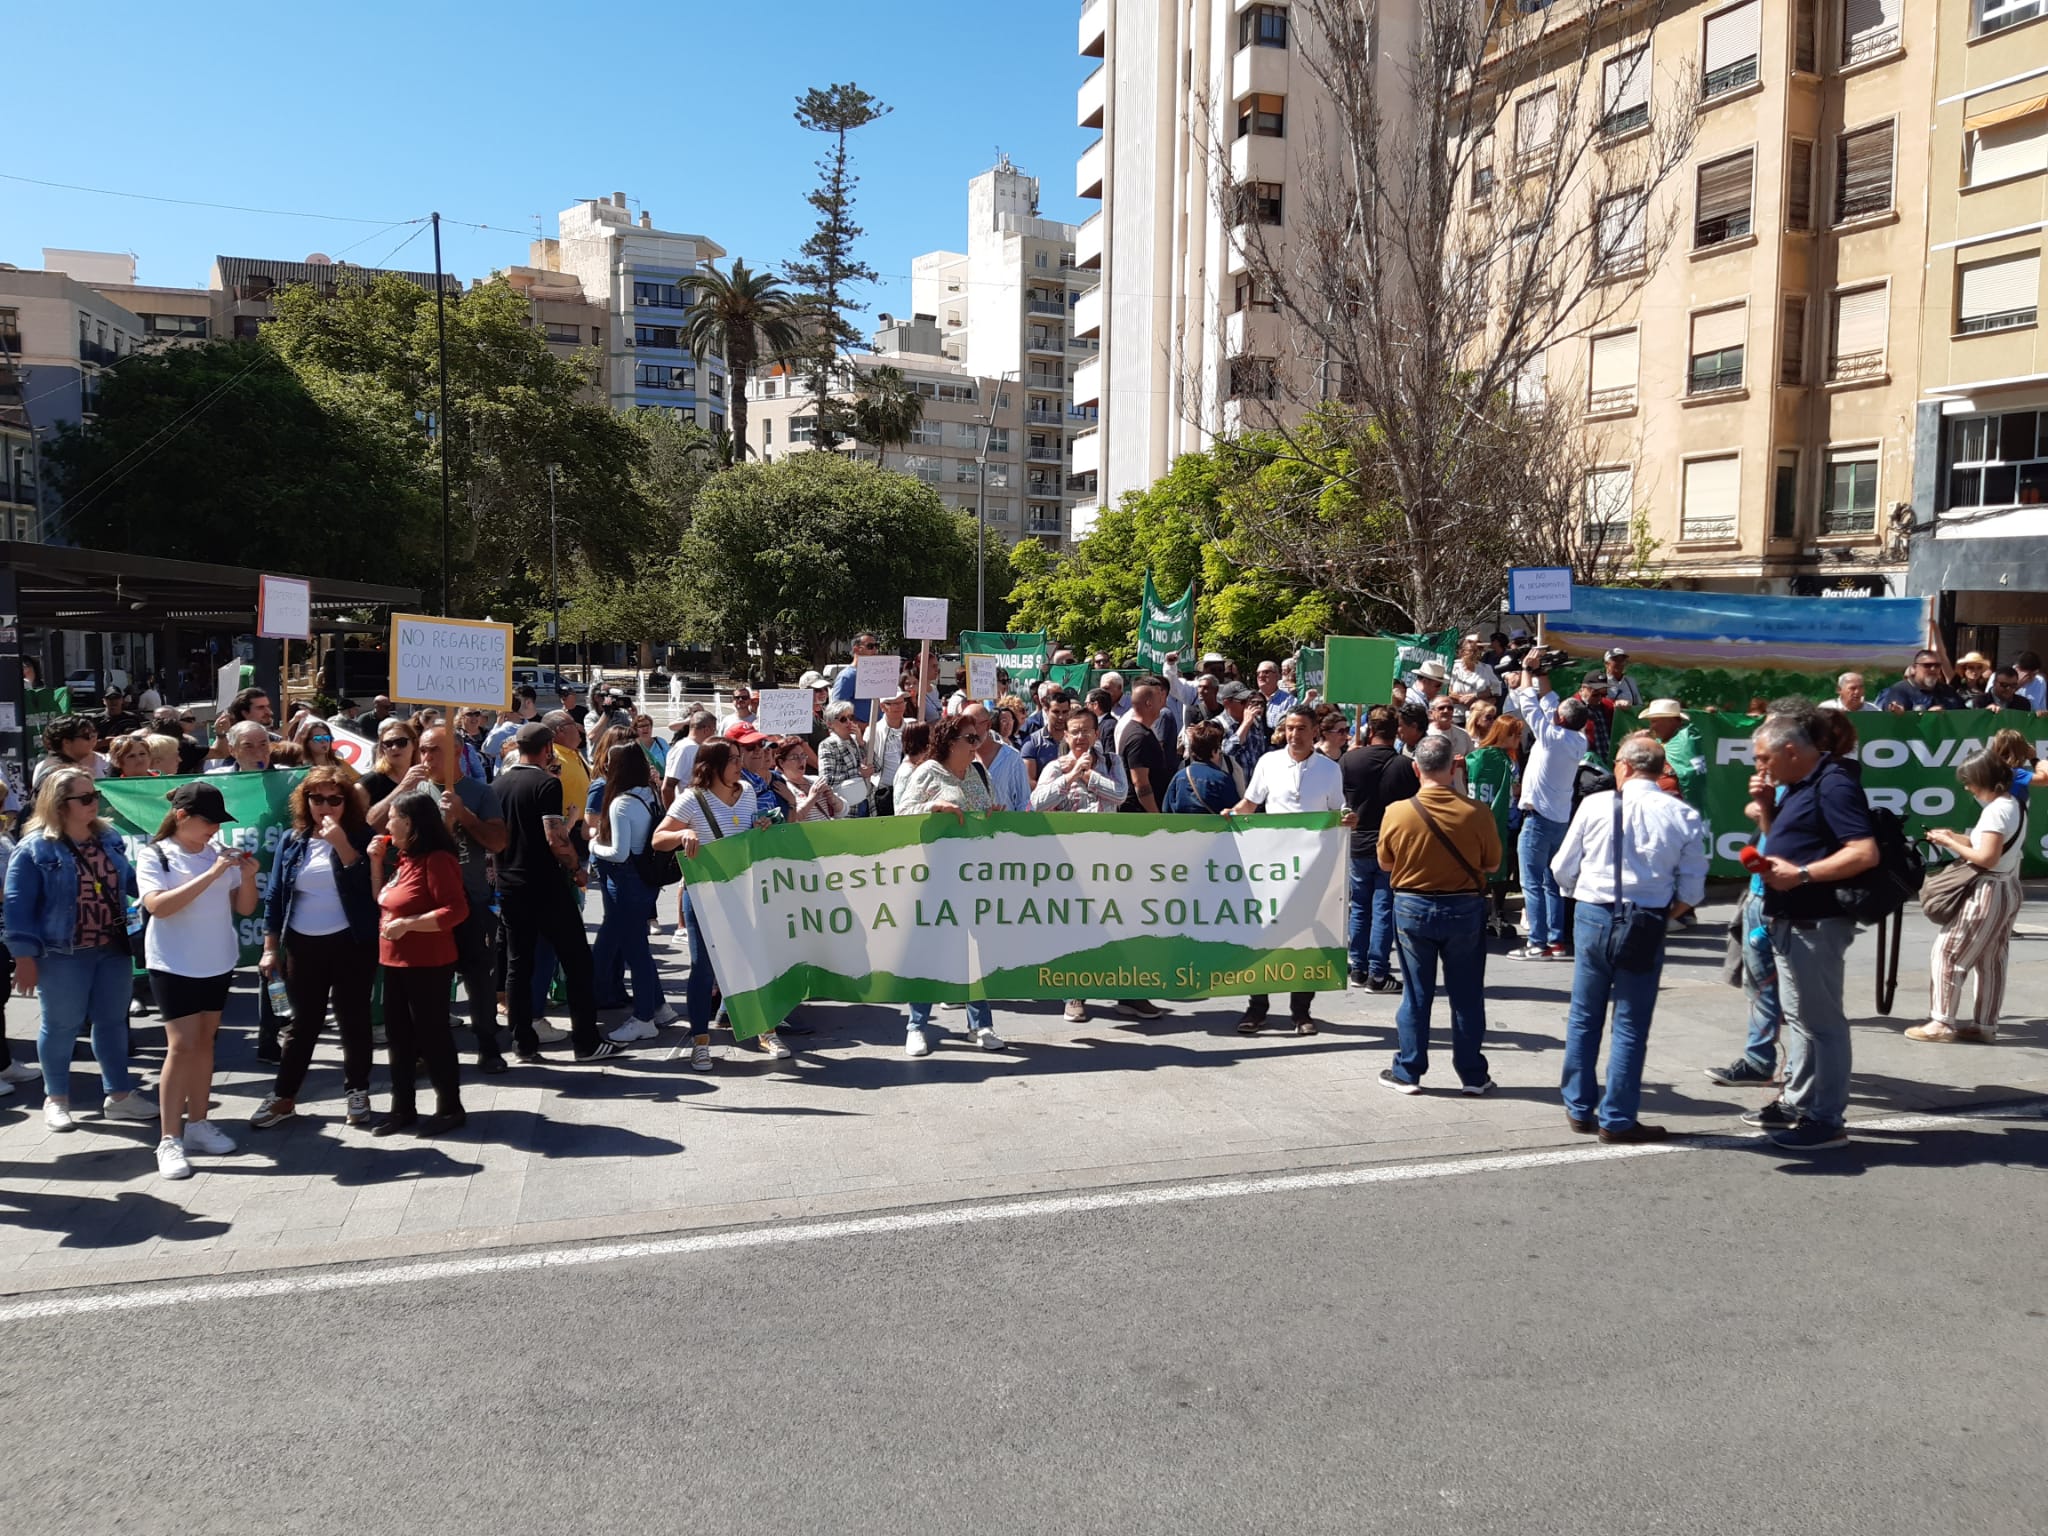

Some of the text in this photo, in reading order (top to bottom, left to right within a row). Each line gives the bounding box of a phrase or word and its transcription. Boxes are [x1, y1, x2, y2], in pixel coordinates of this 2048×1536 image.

[401, 628, 505, 653] NO REGAREIS
[401, 653, 505, 673] CON NUESTRAS
[416, 673, 499, 695] LAGRIMAS
[761, 856, 1301, 904] ¡Nuestro campo no se toca!
[786, 898, 1278, 939] ¡NO A LA PLANTA SOLAR!
[1038, 966, 1167, 989] Renovables,
[1209, 967, 1257, 990] pero
[1264, 962, 1297, 983] NO
[1303, 959, 1333, 981] así
